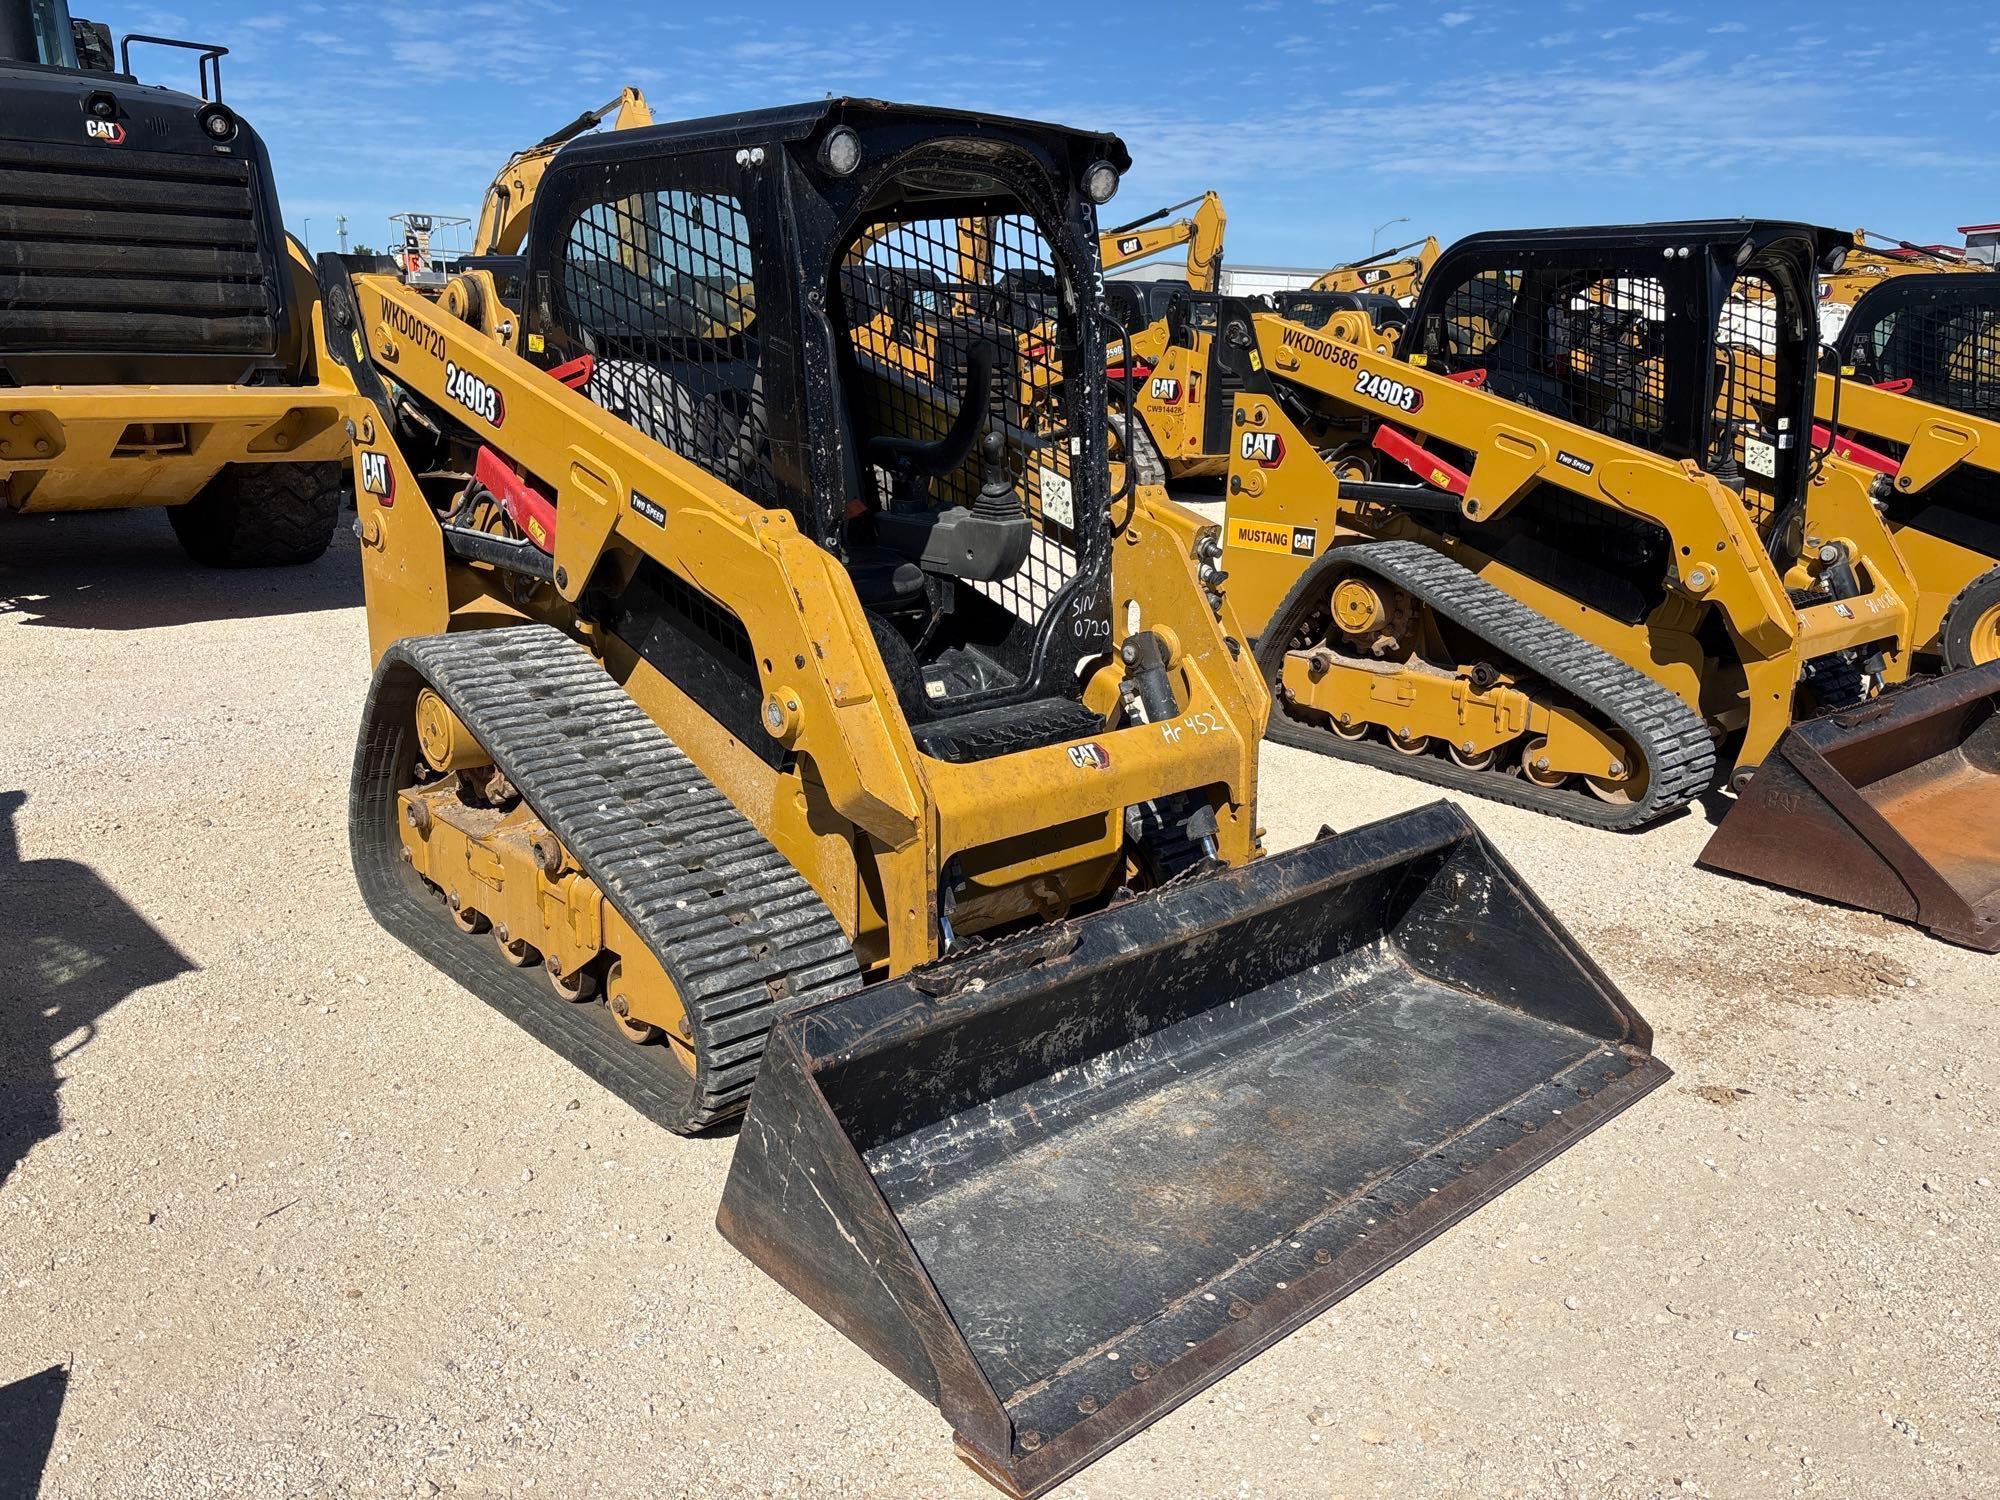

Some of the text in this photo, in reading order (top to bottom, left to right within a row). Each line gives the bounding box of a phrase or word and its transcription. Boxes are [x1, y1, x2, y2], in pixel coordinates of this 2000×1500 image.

[86, 119, 116, 139] CAT
[1123, 239, 1138, 254] CAT
[1365, 270, 1380, 284] CAT
[380, 295, 446, 362] WKD00720
[1282, 327, 1360, 370] WKD00586
[446, 361, 497, 422] 249D3
[1151, 378, 1177, 400] CAT
[1354, 370, 1415, 411] 249D3
[1242, 431, 1277, 461] CAT
[361, 451, 387, 495] CAT
[1239, 528, 1315, 550] MUSTANG CAT
[1074, 618, 1110, 640] 0720
[1185, 711, 1225, 736] 452
[1066, 743, 1101, 768] CAT
